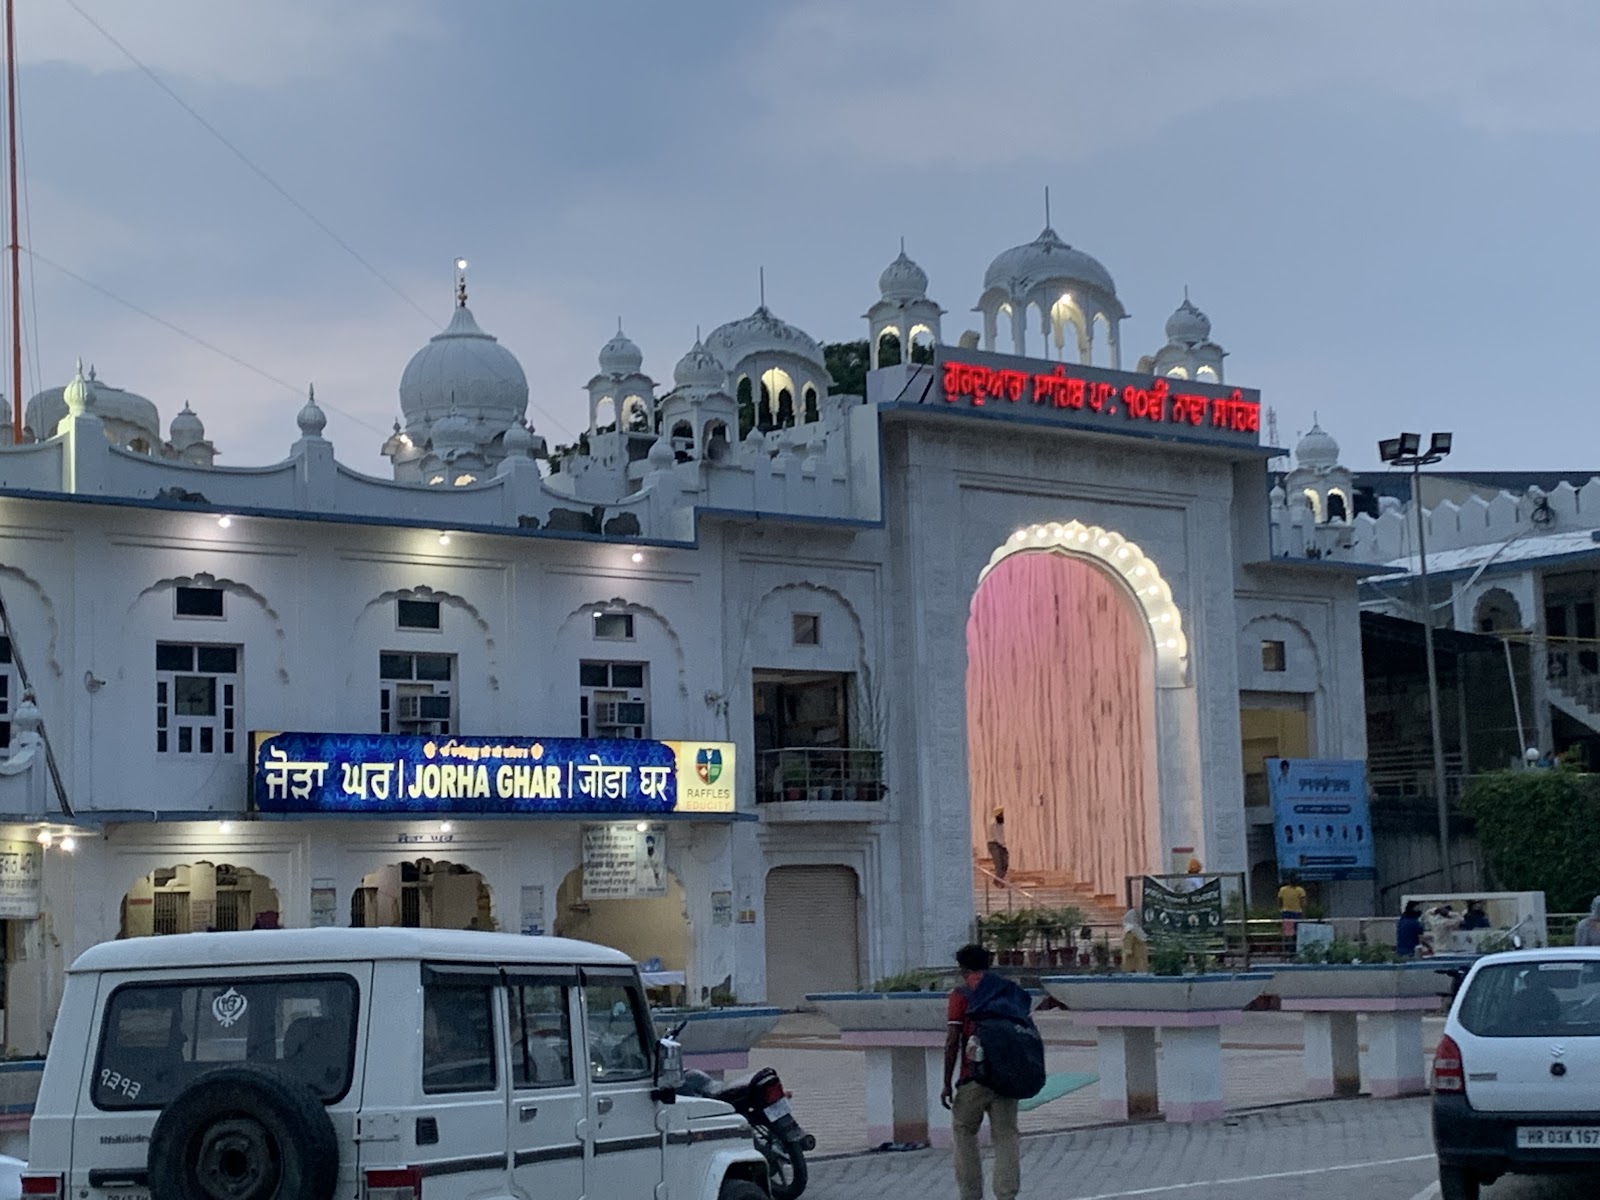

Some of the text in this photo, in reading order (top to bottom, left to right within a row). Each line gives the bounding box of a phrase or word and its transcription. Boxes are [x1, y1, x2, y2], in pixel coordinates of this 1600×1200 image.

[264, 744, 395, 800] ਜੋੜਾ ਘਰ
[408, 764, 562, 799] JORHA GHAR
[639, 766, 671, 802] घर
[686, 801, 730, 811] EDUCITY
[687, 788, 730, 799] RAFFLES
